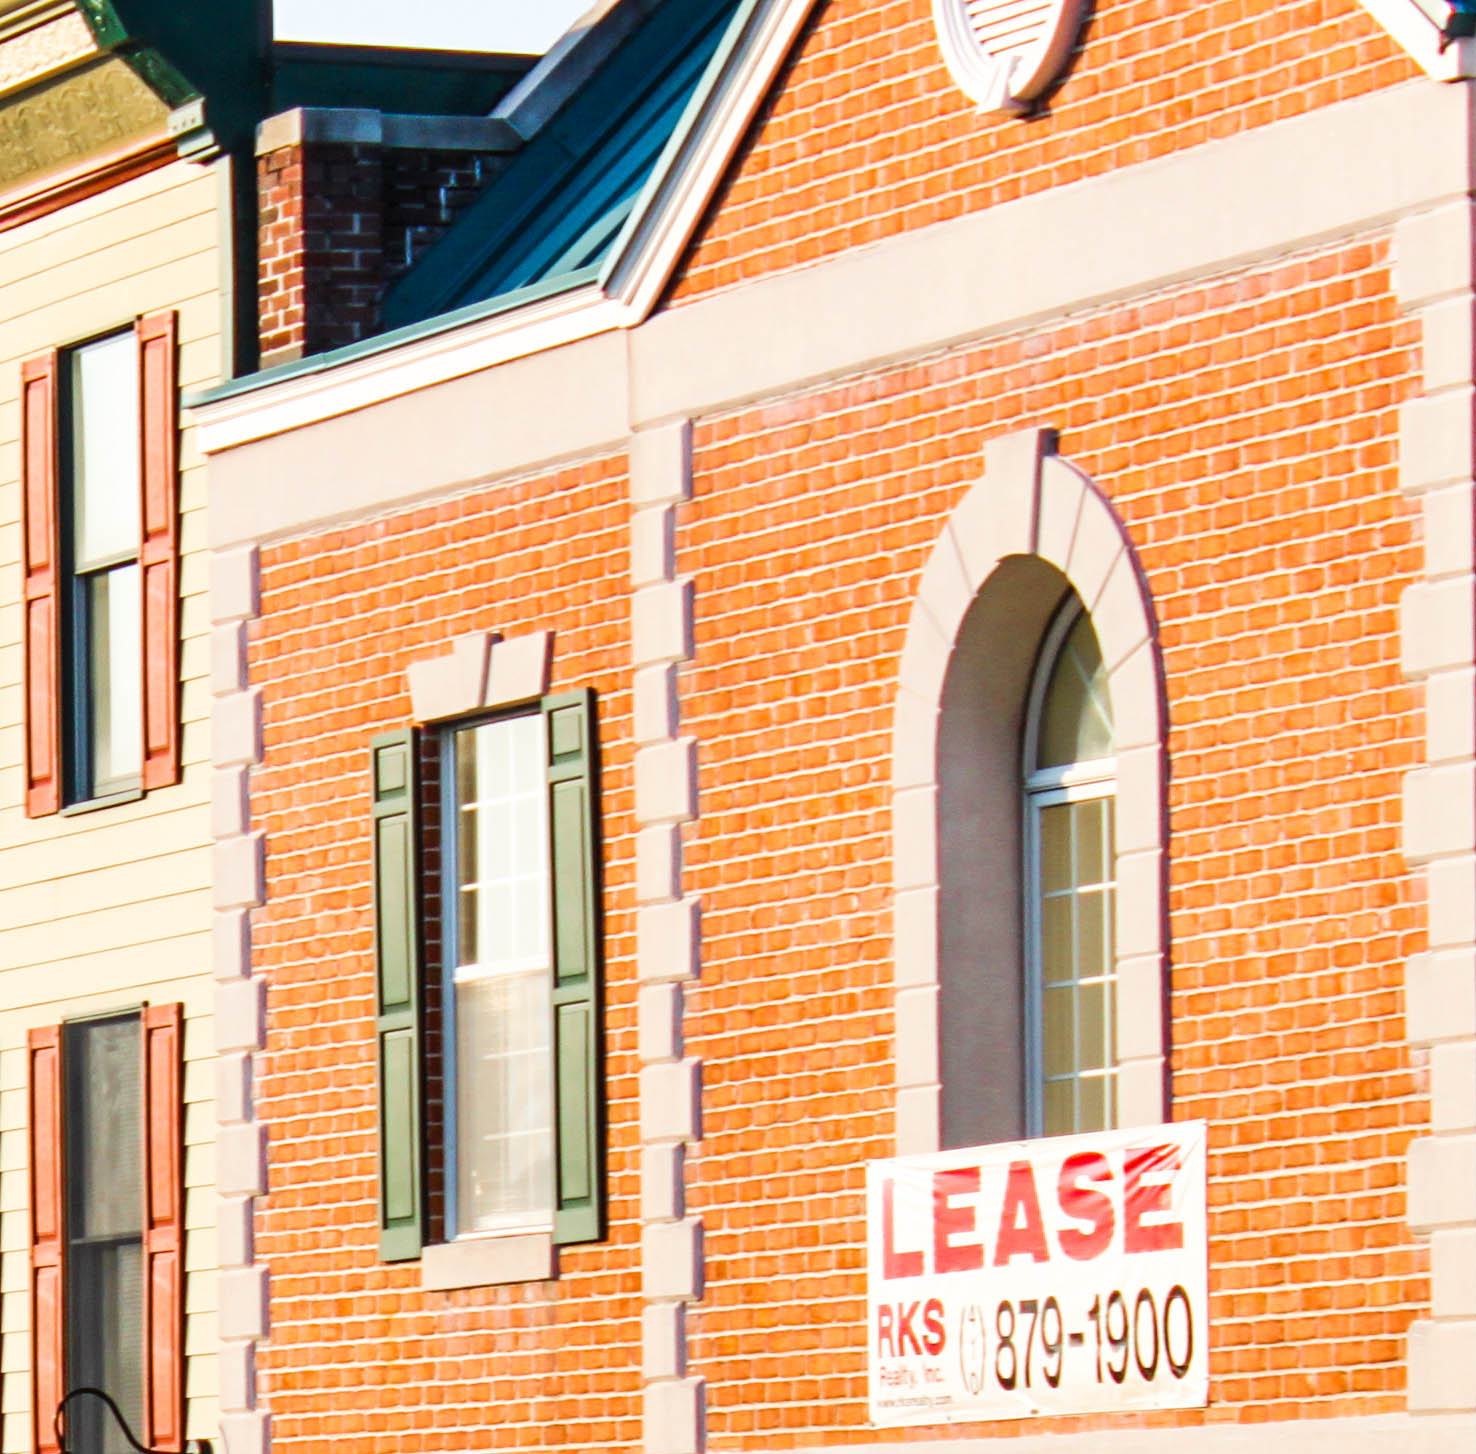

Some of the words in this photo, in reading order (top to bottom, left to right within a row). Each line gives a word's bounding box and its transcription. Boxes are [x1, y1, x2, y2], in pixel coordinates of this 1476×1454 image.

[882, 1143, 1184, 1280] LEASE
[877, 1297, 946, 1359] RKS
[994, 1284, 1194, 1391] 879-1900
